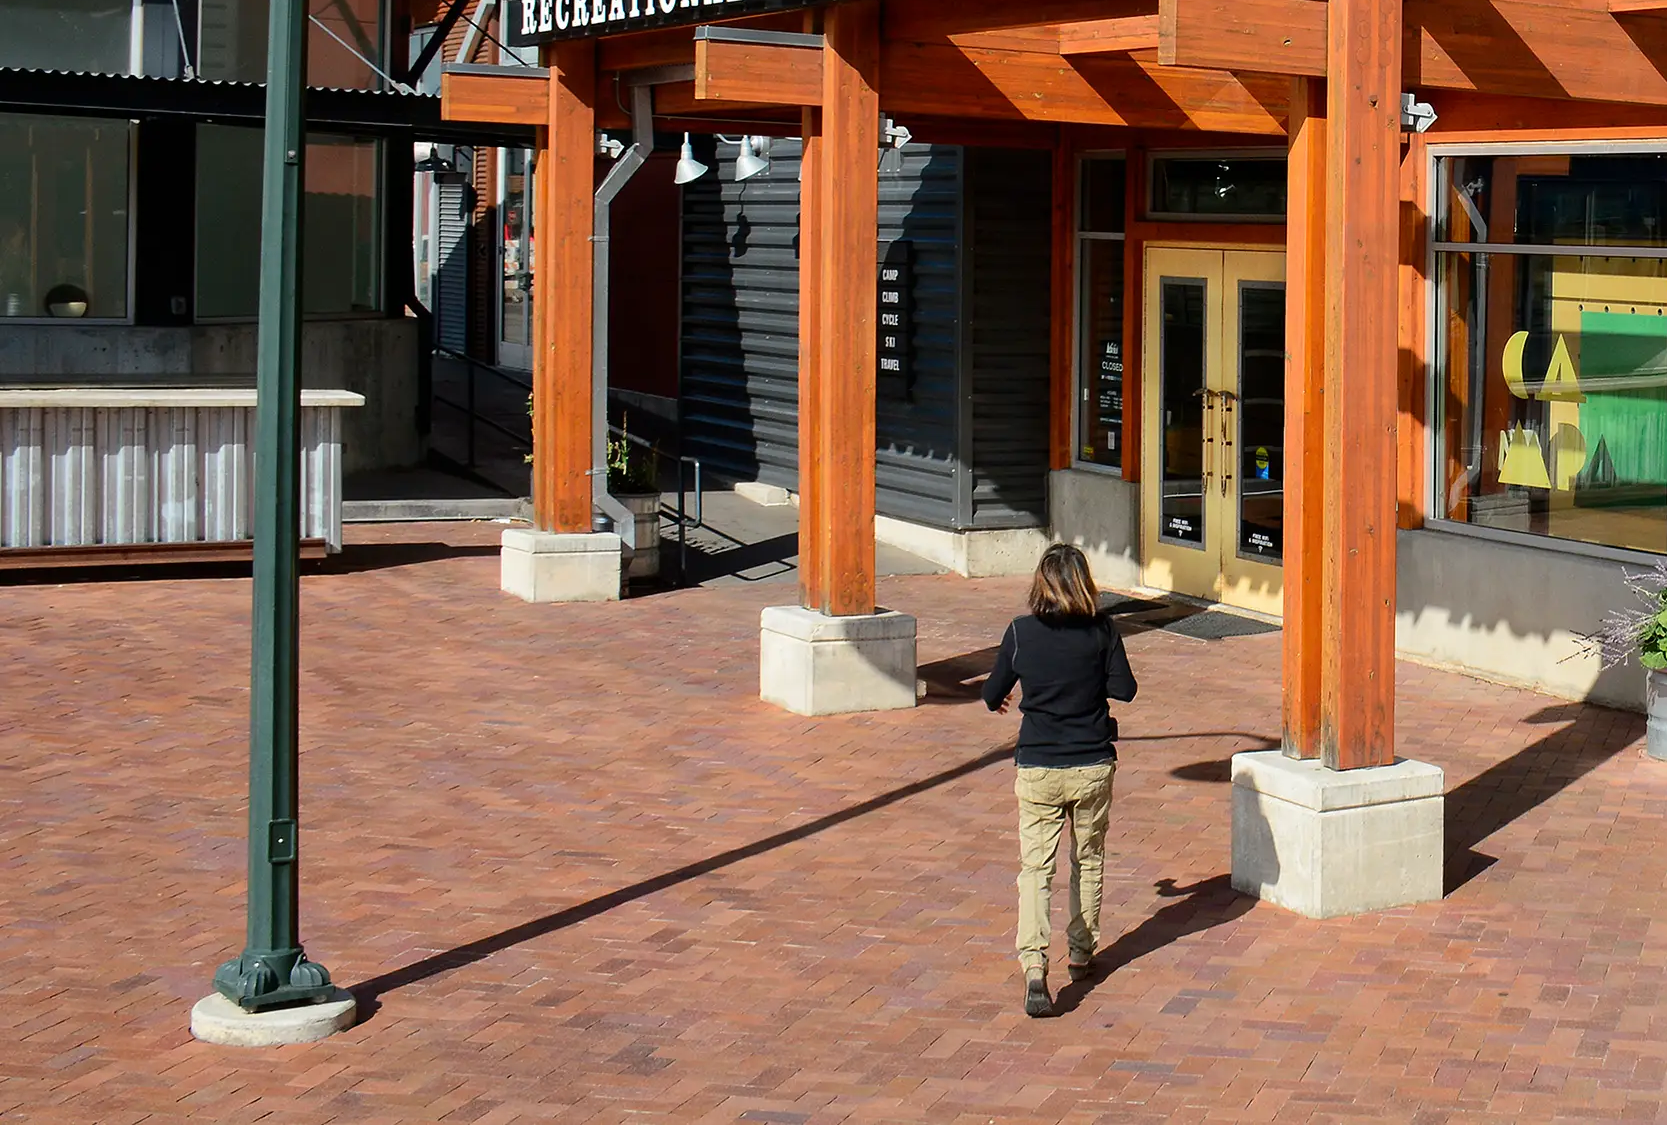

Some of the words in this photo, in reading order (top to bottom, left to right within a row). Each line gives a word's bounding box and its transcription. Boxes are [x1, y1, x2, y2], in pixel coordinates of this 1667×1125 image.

[882, 269, 898, 281] CAMP
[882, 291, 899, 304] CLIMB
[881, 313, 899, 326] CYCLE
[885, 336, 896, 348] SKI
[880, 358, 900, 372] TRAVEL
[1101, 361, 1124, 372] CLOSED
